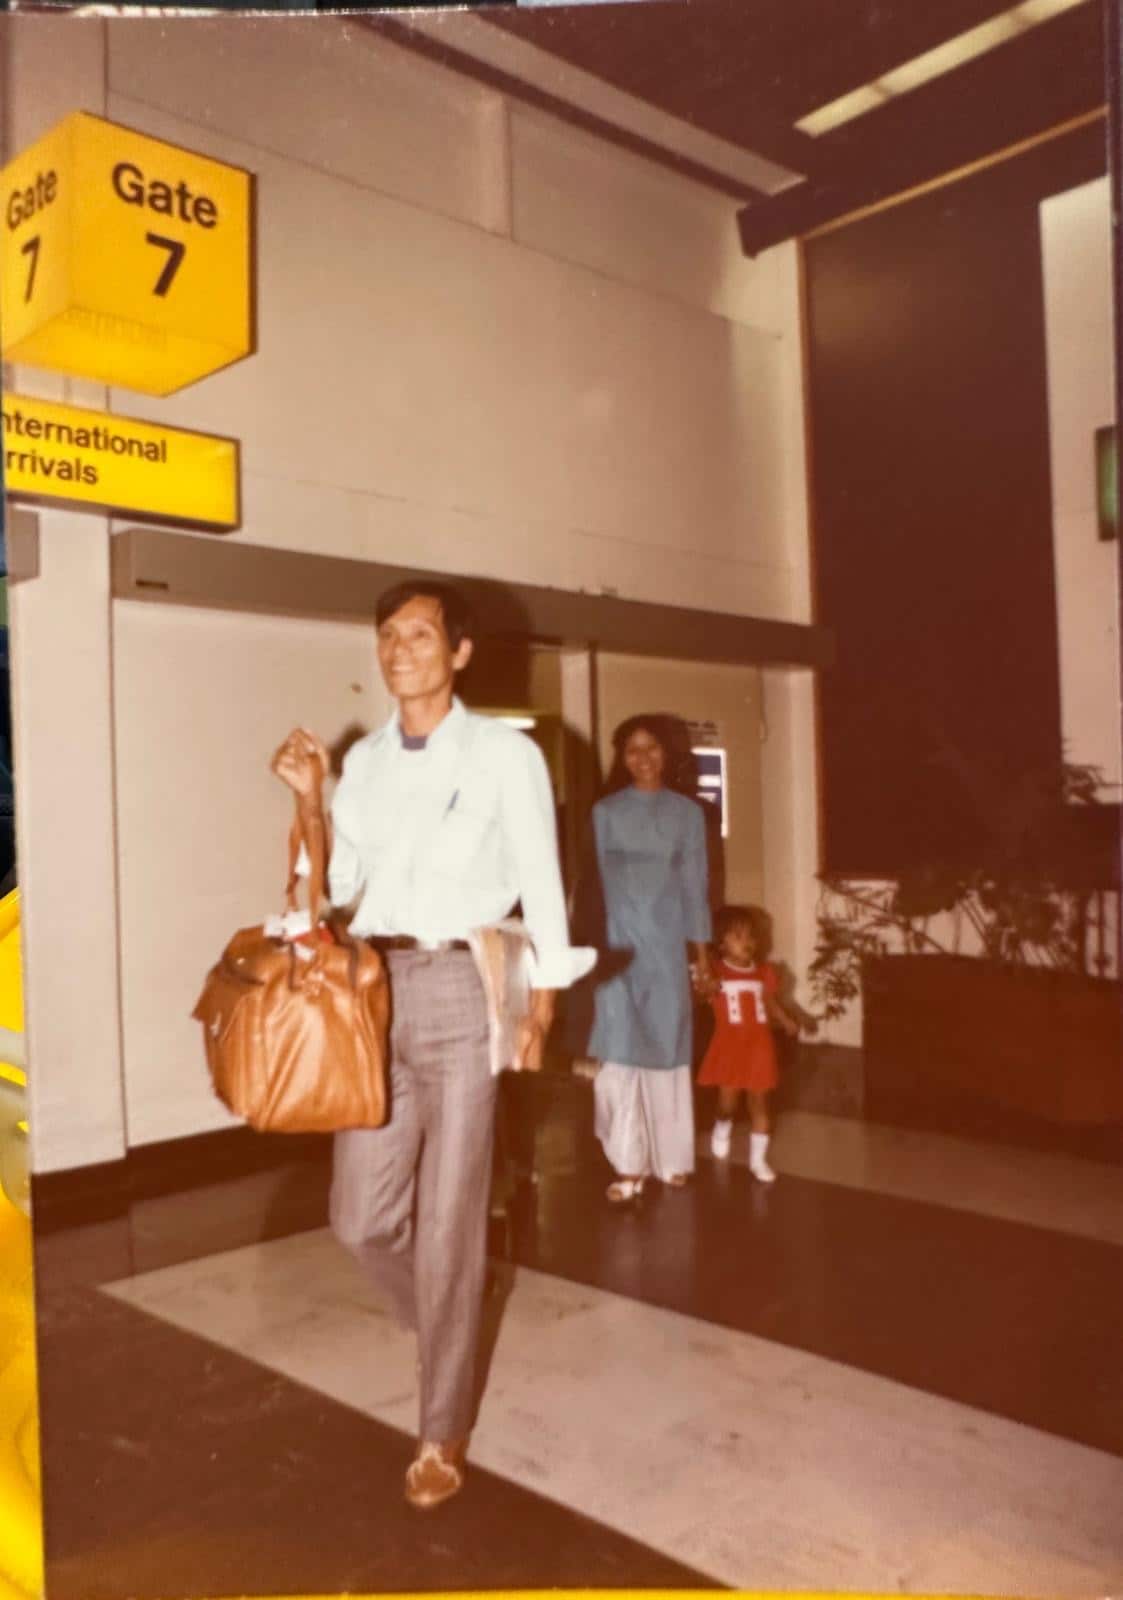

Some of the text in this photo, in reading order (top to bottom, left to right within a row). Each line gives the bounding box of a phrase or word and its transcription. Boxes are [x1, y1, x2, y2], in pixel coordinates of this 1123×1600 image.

[6, 169, 58, 231] Gate
[112, 162, 218, 229] Gate
[21, 233, 41, 304] 7
[145, 232, 187, 298] 7
[7, 449, 99, 485] rrivals
